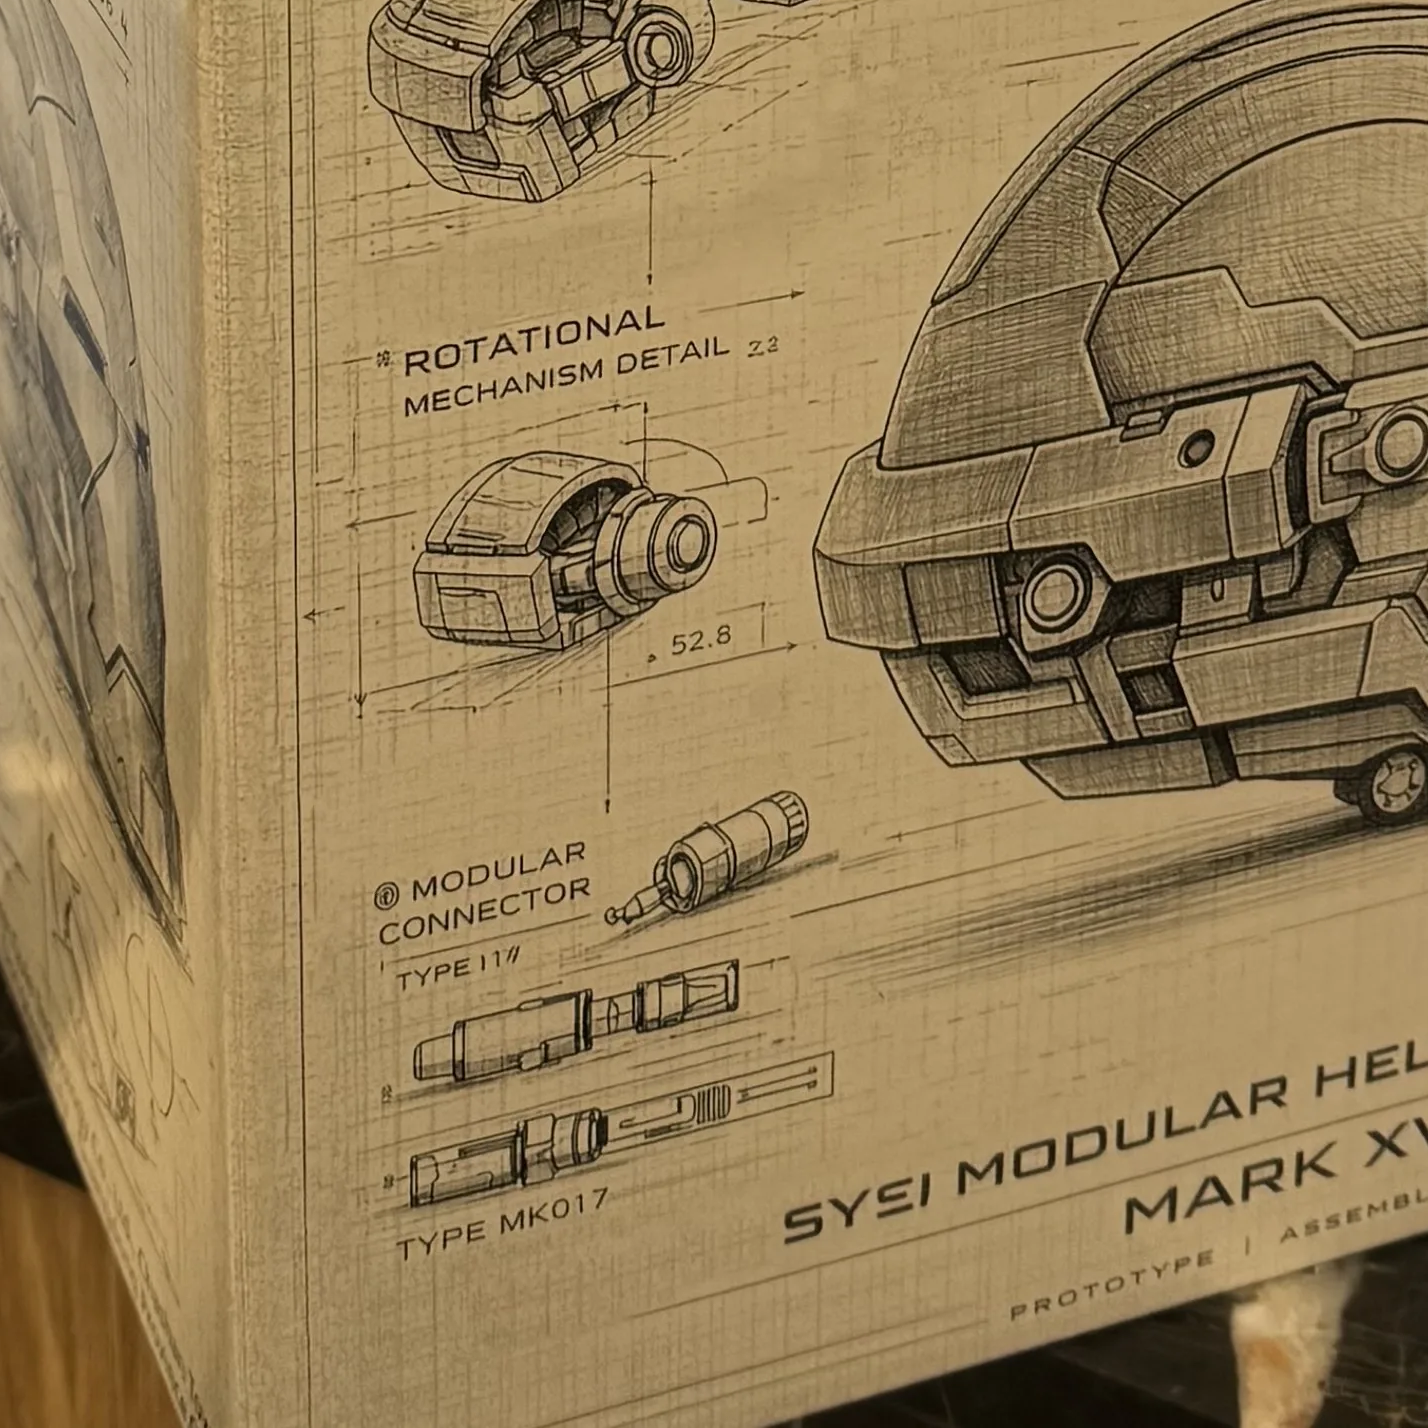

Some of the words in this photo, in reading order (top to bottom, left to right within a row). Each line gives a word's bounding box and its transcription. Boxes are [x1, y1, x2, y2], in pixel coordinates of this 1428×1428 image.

[404, 304, 666, 377] ROTATIONAL
[404, 358, 603, 417] MECHANISM
[616, 336, 730, 375] DETAIL
[671, 624, 732, 656] 52.8
[412, 841, 586, 902] MODULAR
[378, 877, 591, 945] CONNECTOR
[395, 956, 471, 992] TYPE
[956, 1074, 1288, 1196] MODULAR
[395, 1220, 486, 1261] TYPE
[499, 1186, 609, 1235] MK017
[1124, 1141, 1339, 1235] MARK
[1010, 1248, 1214, 1322] PROTOTYPE
